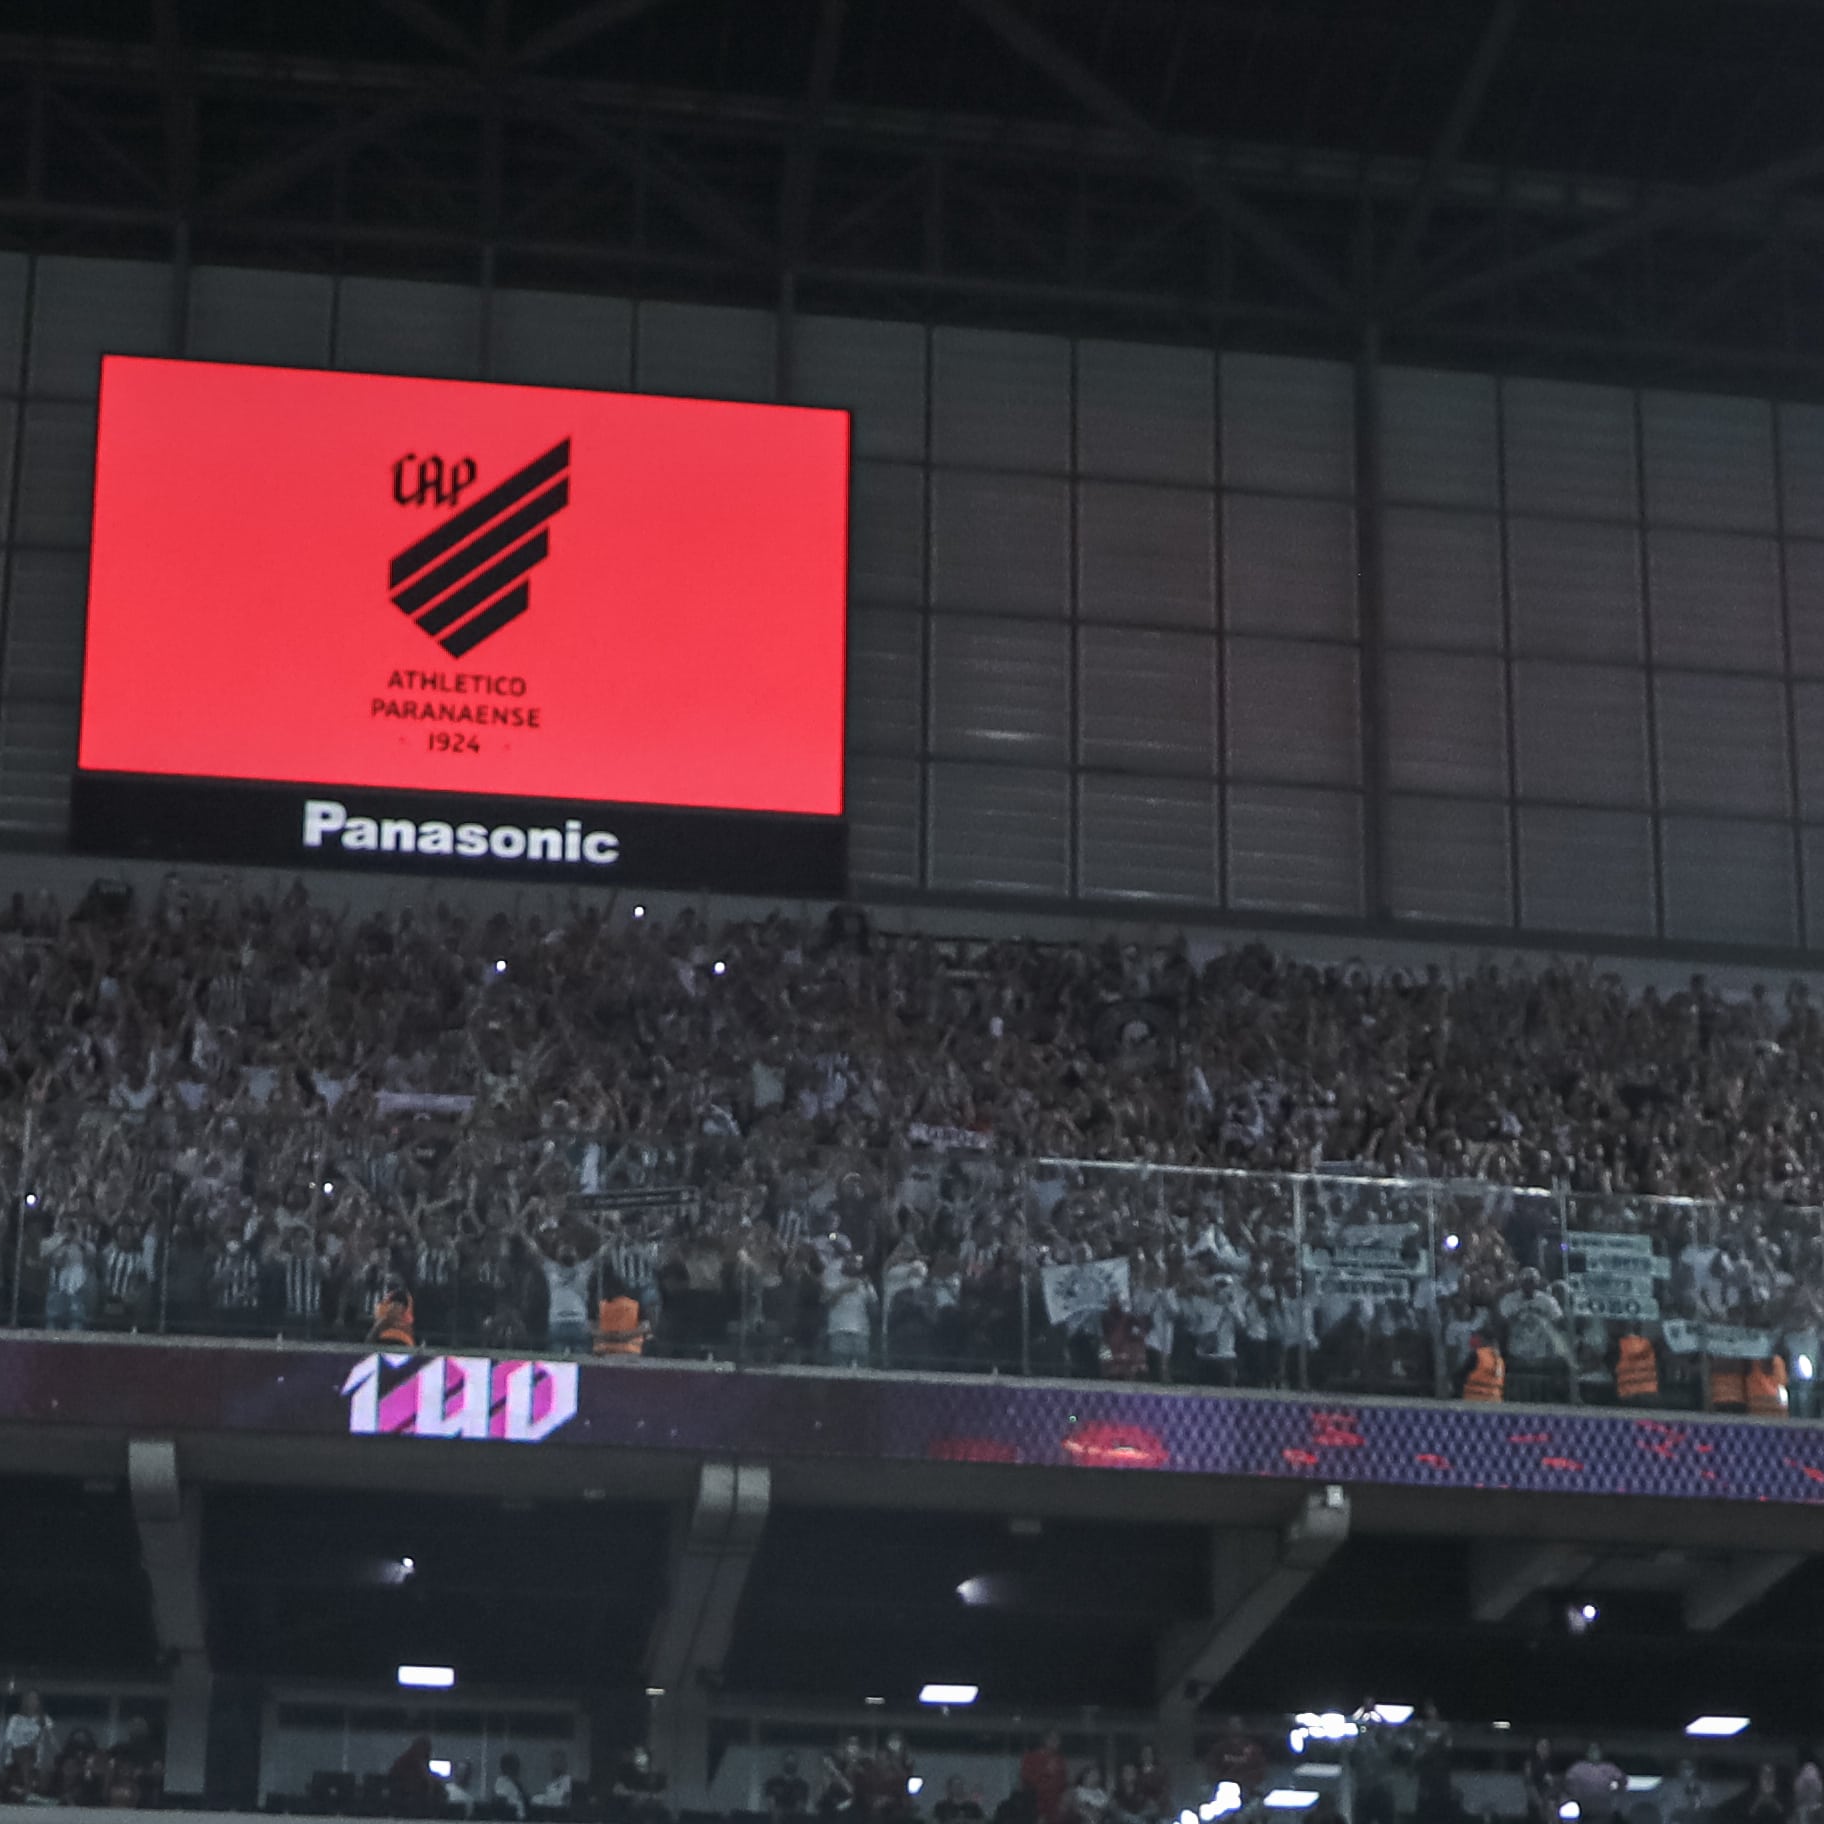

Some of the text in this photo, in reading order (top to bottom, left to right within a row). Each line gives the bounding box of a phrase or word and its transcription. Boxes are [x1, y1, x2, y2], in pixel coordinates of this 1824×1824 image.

[392, 452, 478, 507] CAP
[386, 670, 528, 698] ATHLETICO
[370, 699, 542, 729] PARANAENSE
[426, 732, 481, 756] 1924
[302, 800, 621, 865] Panasonic
